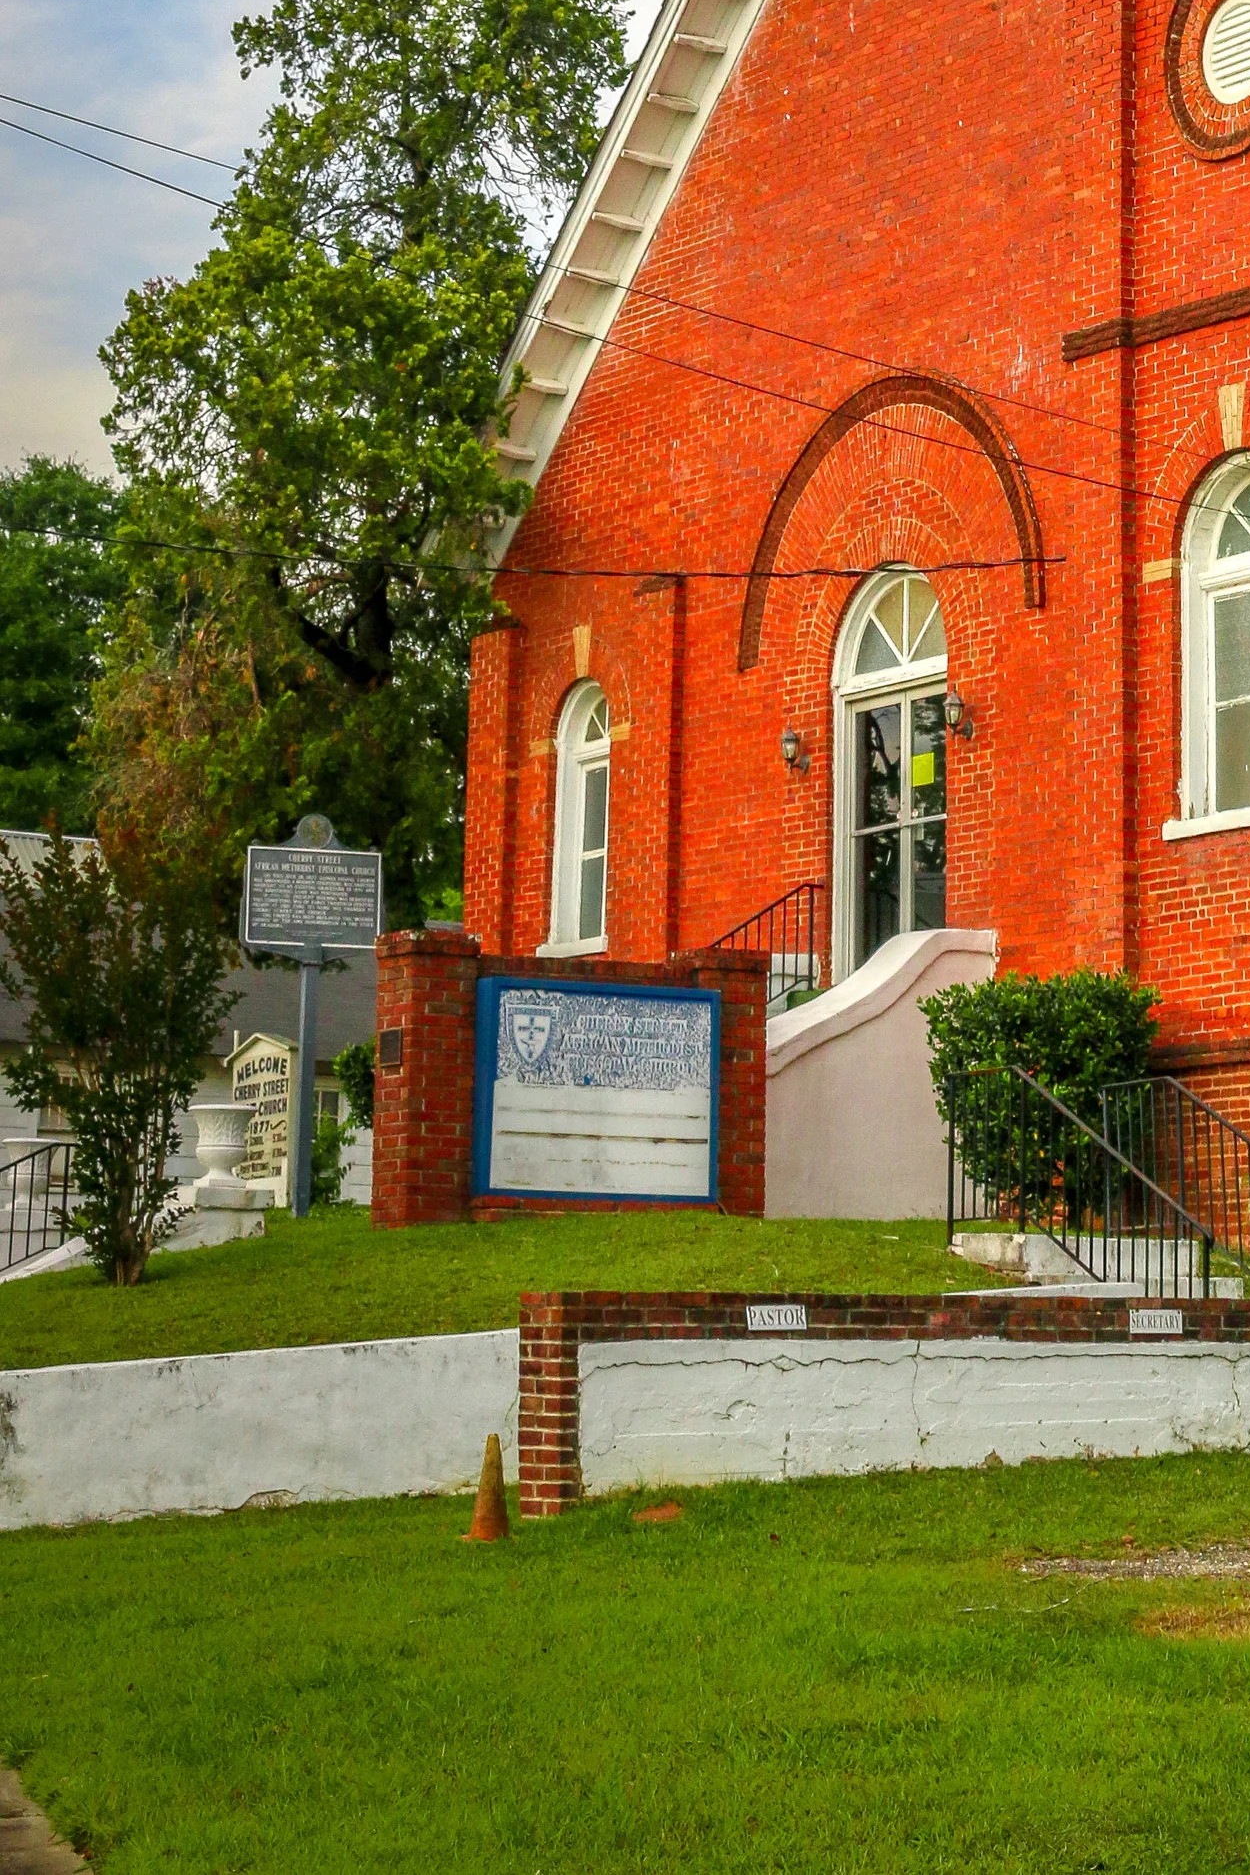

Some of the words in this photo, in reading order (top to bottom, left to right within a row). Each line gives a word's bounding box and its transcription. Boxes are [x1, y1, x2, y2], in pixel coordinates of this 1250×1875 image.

[317, 855, 341, 864] STREET
[236, 1056, 288, 1084] WELCOME
[234, 1082, 261, 1101] CHERRY
[263, 1078, 289, 1097] STREET
[258, 1097, 288, 1116] CHURCH
[250, 1120, 270, 1135] 1877
[748, 1308, 805, 1326] PASTOR
[1131, 1314, 1179, 1329] SECRETARY
